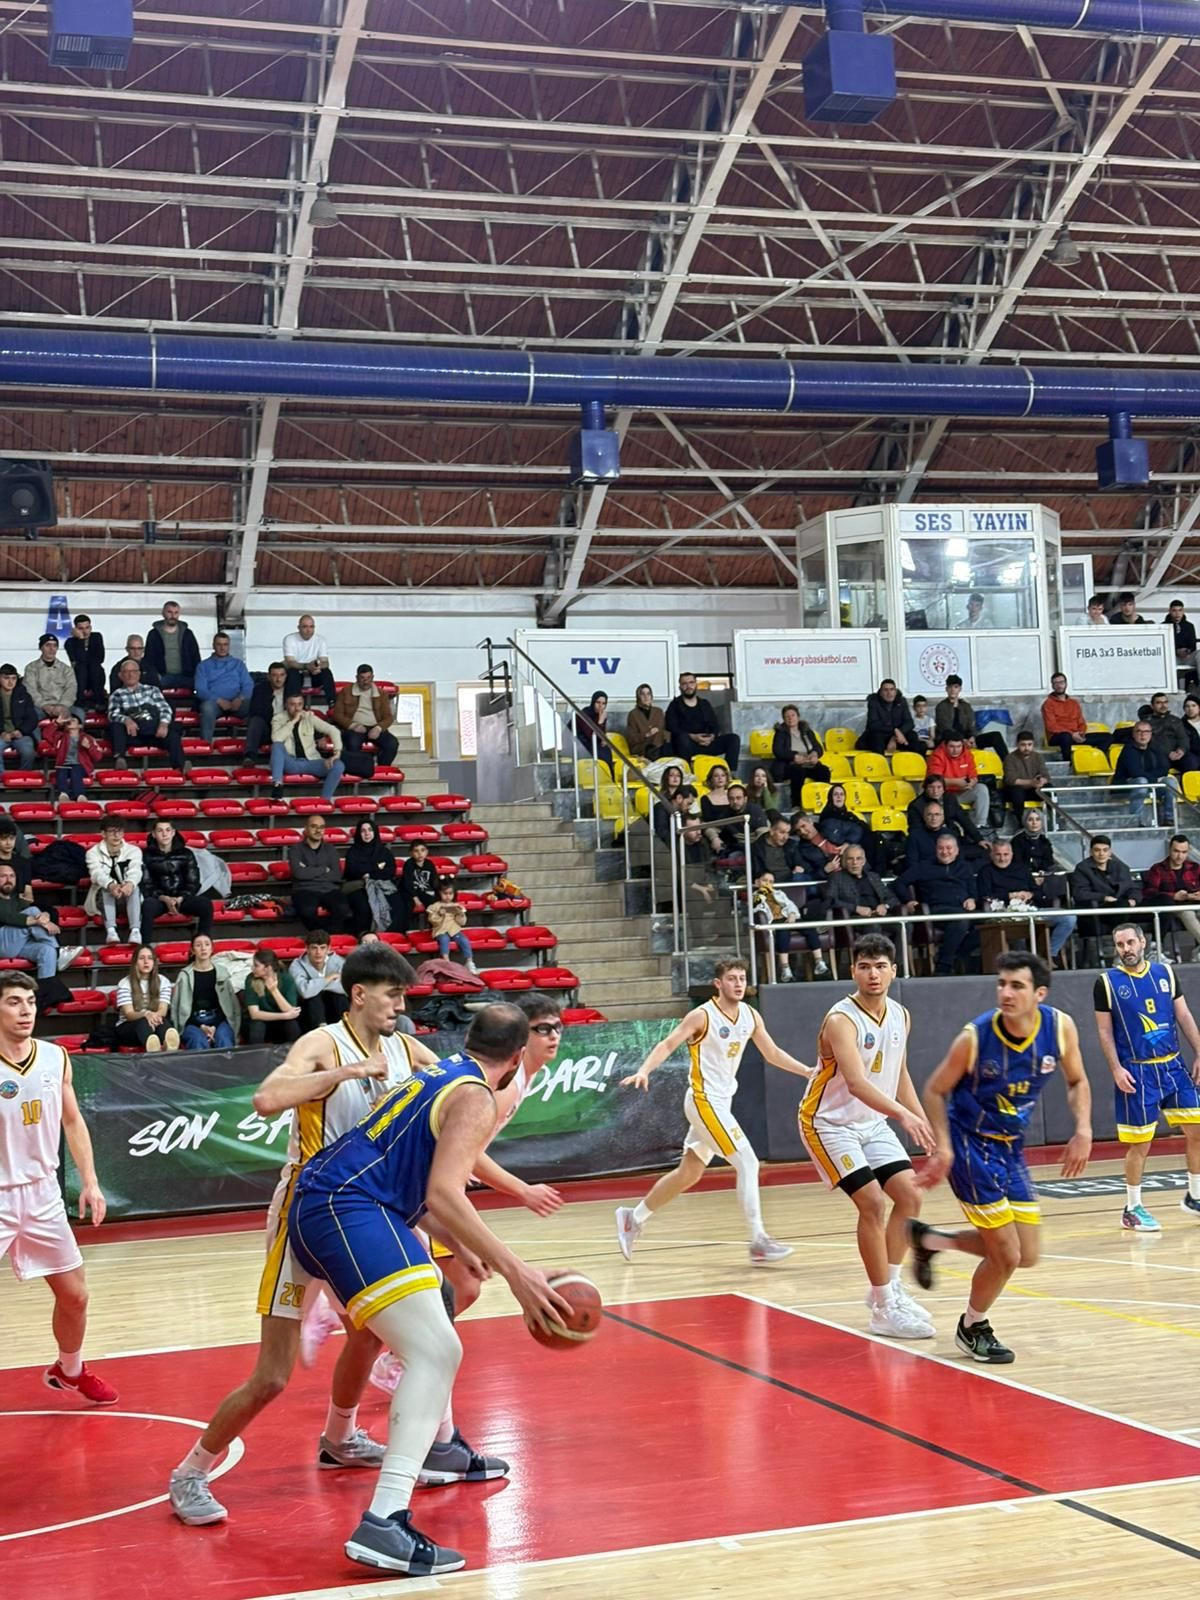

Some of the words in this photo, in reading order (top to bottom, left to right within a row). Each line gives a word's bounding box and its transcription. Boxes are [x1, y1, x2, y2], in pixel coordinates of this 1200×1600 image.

[915, 513, 952, 531] SES
[973, 512, 1028, 531] YAYIN
[764, 654, 858, 666] www.sakaryabasketbol.com
[1076, 648, 1098, 659] FIBA
[1099, 647, 1115, 658] 3x3
[1117, 647, 1162, 657] Basketball
[571, 657, 621, 675] TV
[1144, 998, 1157, 1014] 8
[21, 1099, 42, 1125] 10
[128, 1111, 220, 1157] SON
